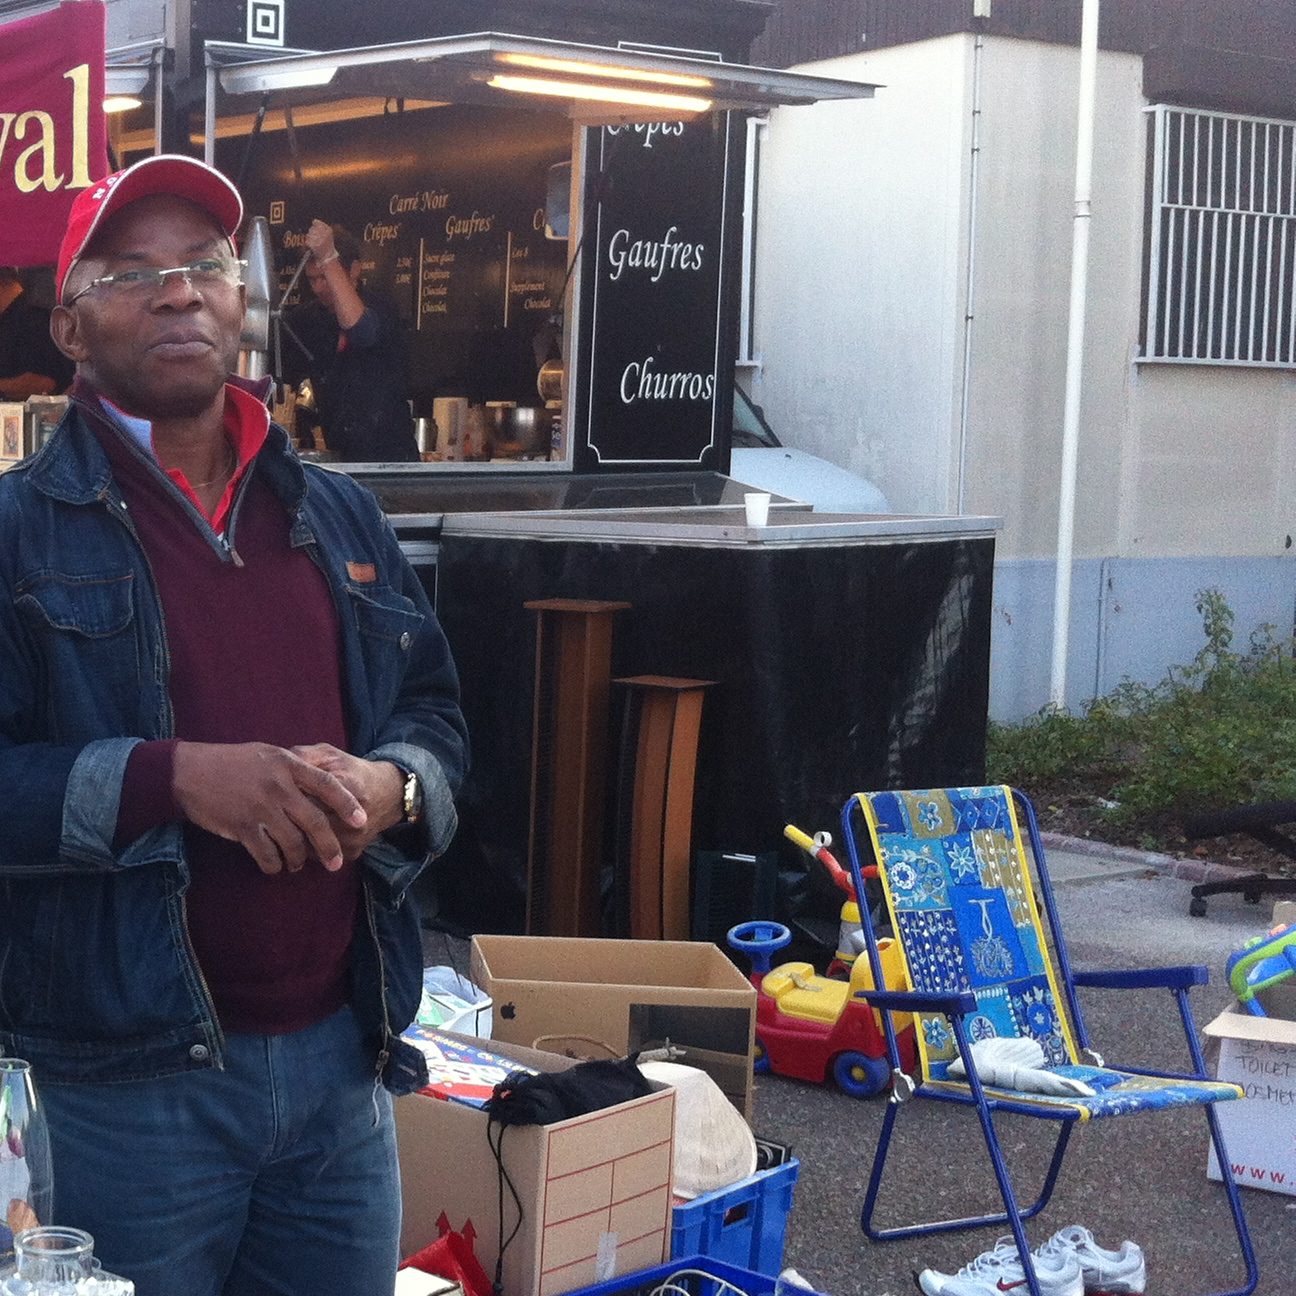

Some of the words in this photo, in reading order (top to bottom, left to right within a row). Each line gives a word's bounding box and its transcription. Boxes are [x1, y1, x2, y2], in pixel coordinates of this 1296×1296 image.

[389, 192, 419, 215] Carré
[420, 189, 449, 212] Noir
[608, 226, 705, 282] Gaufres
[620, 356, 715, 404] Churros
